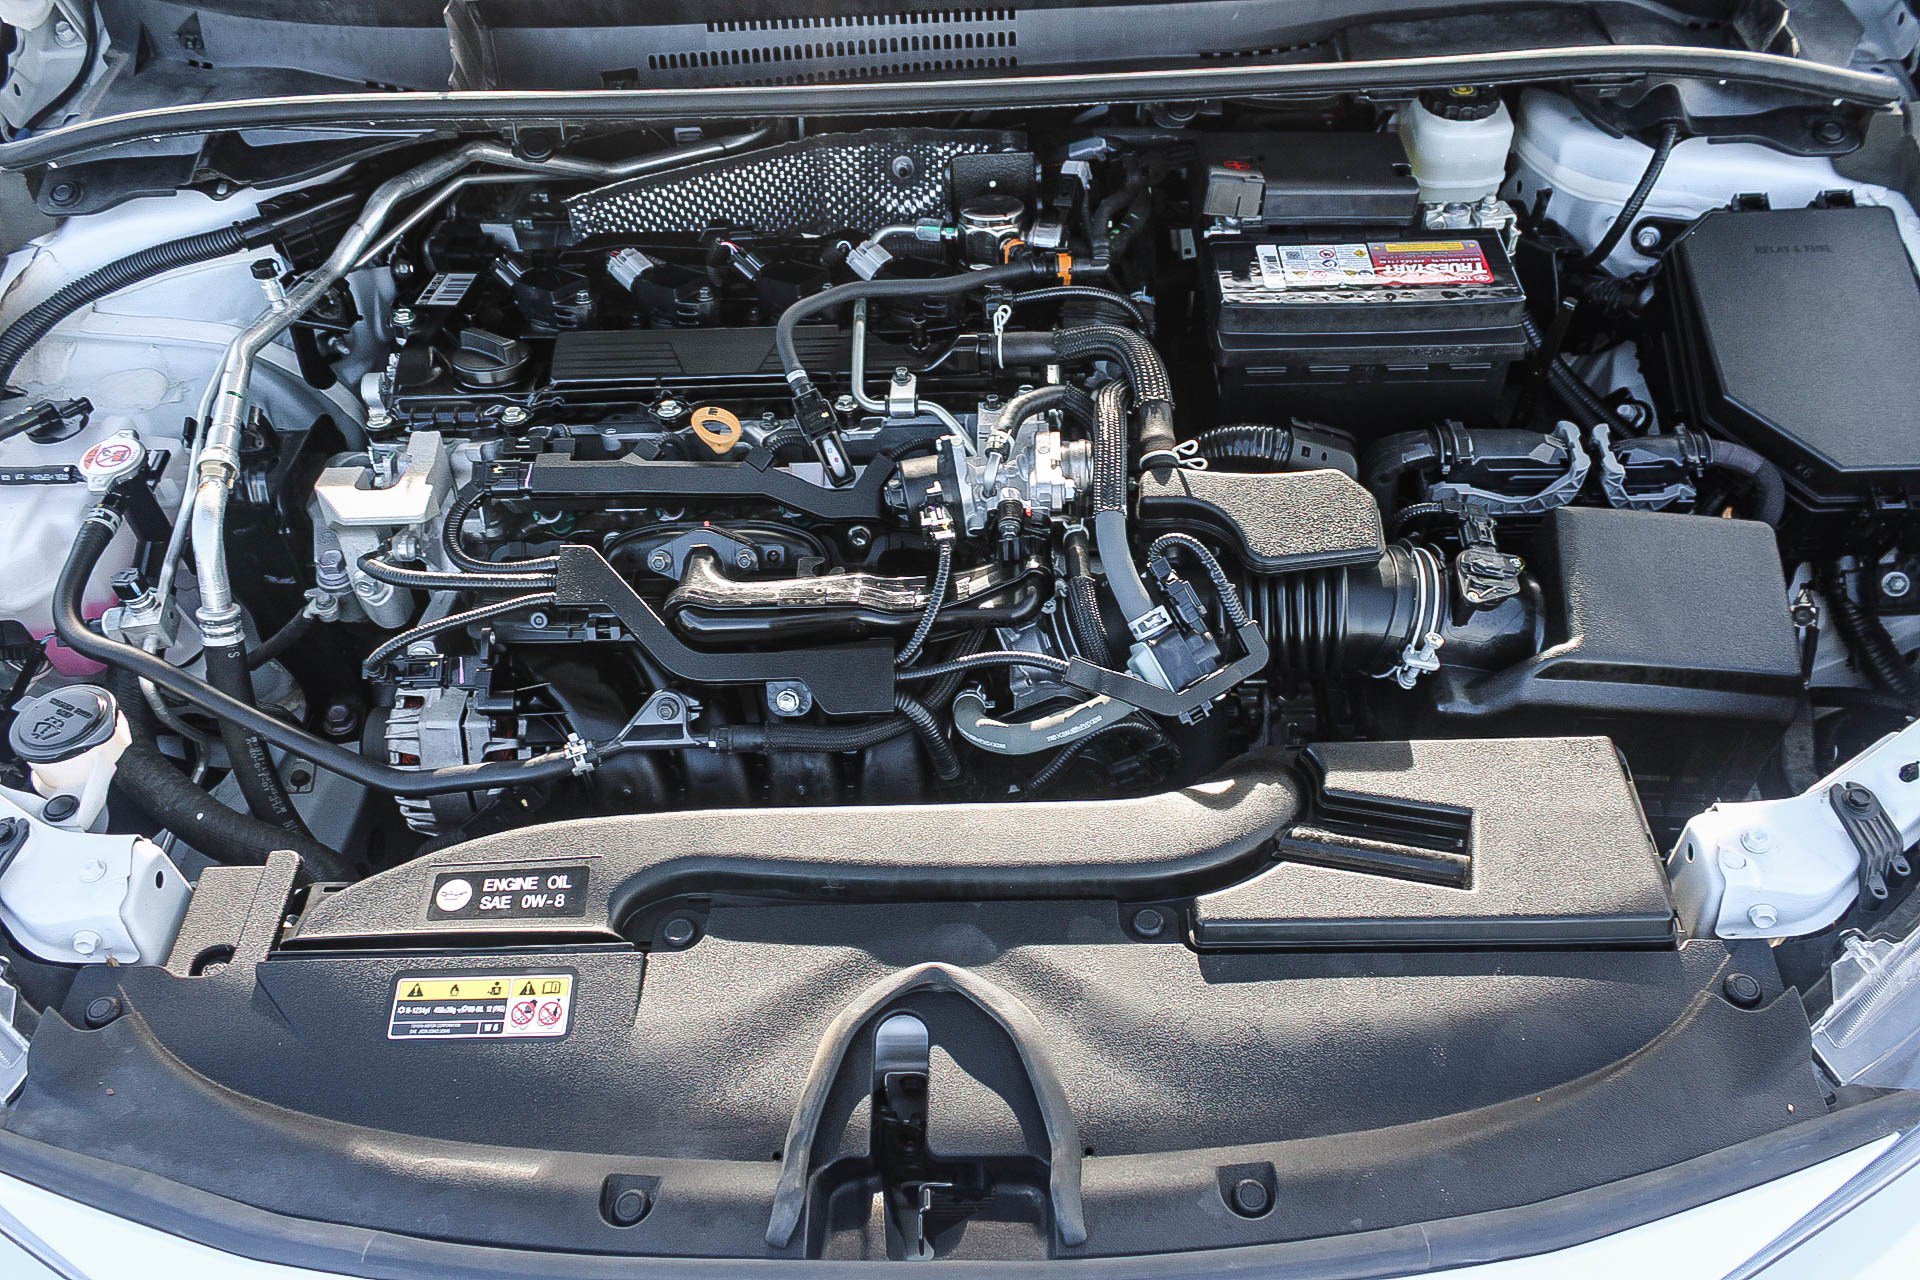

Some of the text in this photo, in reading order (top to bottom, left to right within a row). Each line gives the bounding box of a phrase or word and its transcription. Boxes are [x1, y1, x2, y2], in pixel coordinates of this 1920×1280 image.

[1383, 261, 1488, 275] TRUESTART
[482, 874, 572, 892] ENGINE OIL
[479, 893, 565, 910] SAE 0W-8
